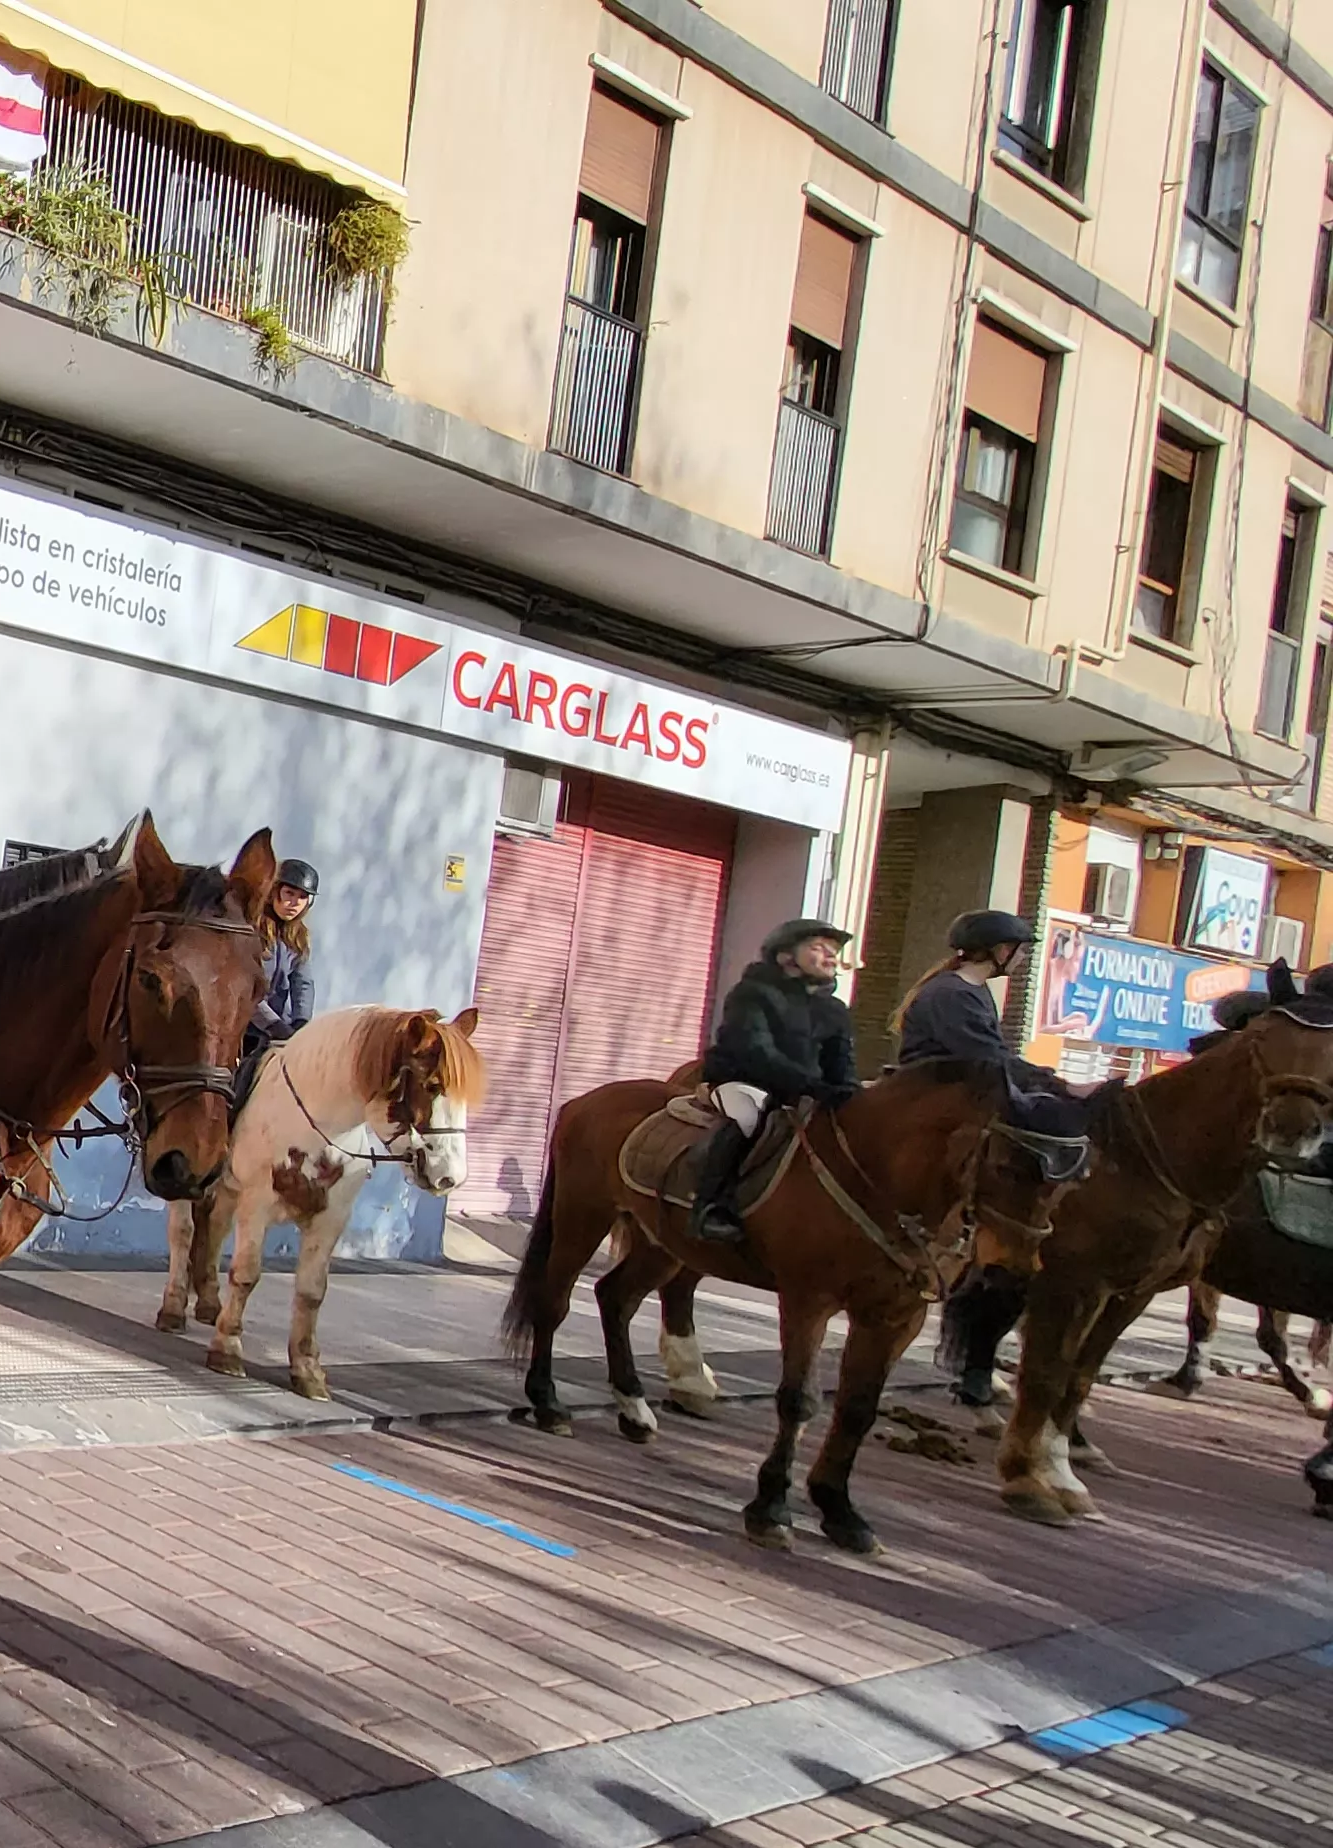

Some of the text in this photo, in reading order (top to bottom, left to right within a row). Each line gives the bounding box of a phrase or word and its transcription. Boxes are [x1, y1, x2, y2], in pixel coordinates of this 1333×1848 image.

[48, 538, 75, 563] en
[82, 547, 183, 593] cristalería
[32, 570, 61, 598] de
[69, 584, 167, 627] vehículos
[452, 651, 710, 769] CARGLASS
